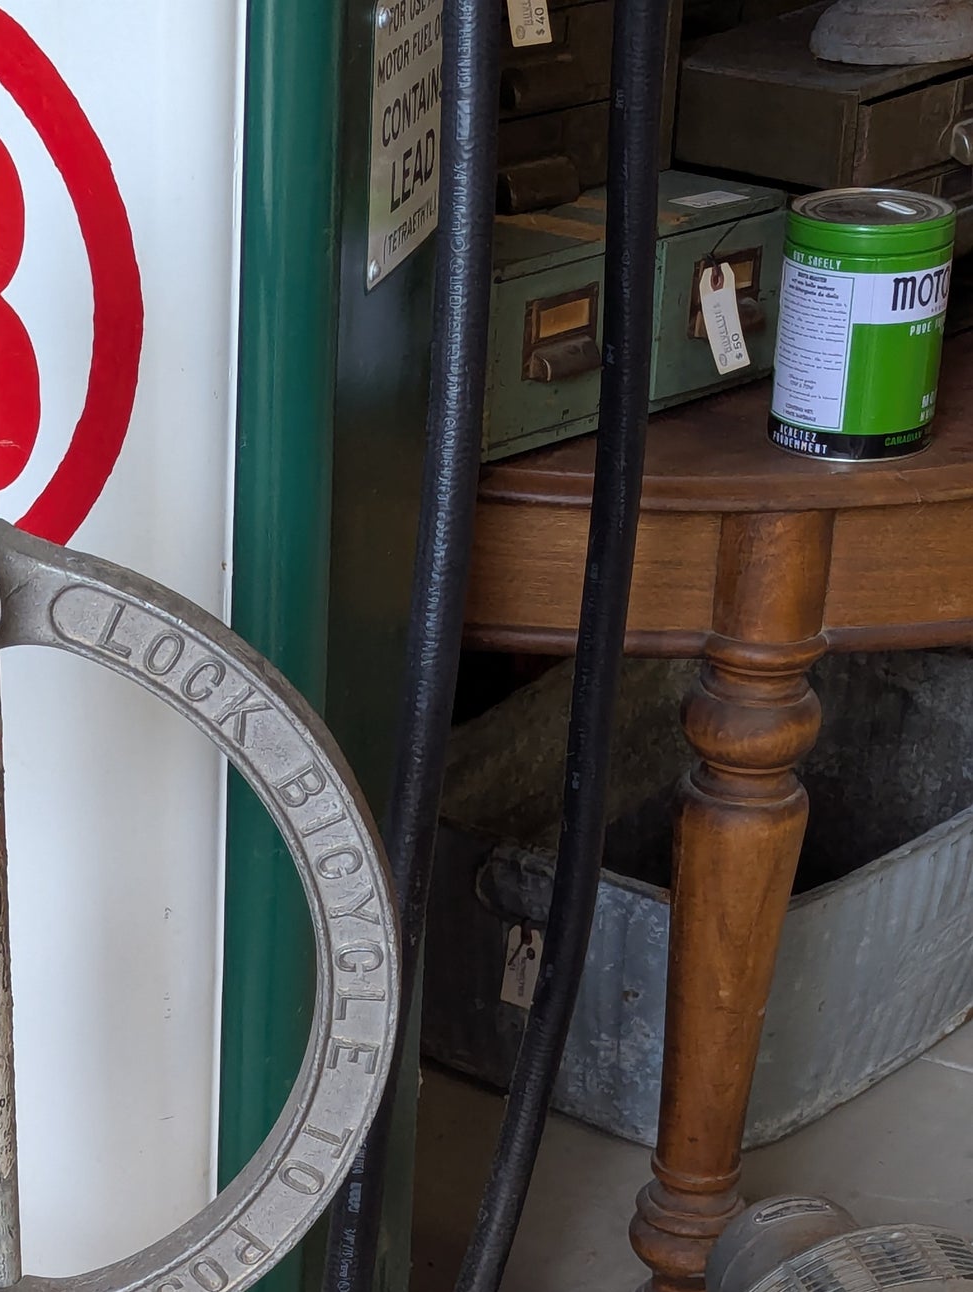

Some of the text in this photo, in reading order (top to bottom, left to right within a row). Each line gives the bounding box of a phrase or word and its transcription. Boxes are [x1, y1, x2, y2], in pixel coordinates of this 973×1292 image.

[377, 39, 409, 88] MOTOR
[413, 21, 432, 58] FUEL
[390, 128, 435, 213] LEAD
[808, 255, 841, 270] SAFELY
[731, 333, 743, 350] 50
[95, 602, 274, 748] LOCK
[277, 761, 386, 1075] BICYCLE
[278, 1123, 356, 1196] TO
